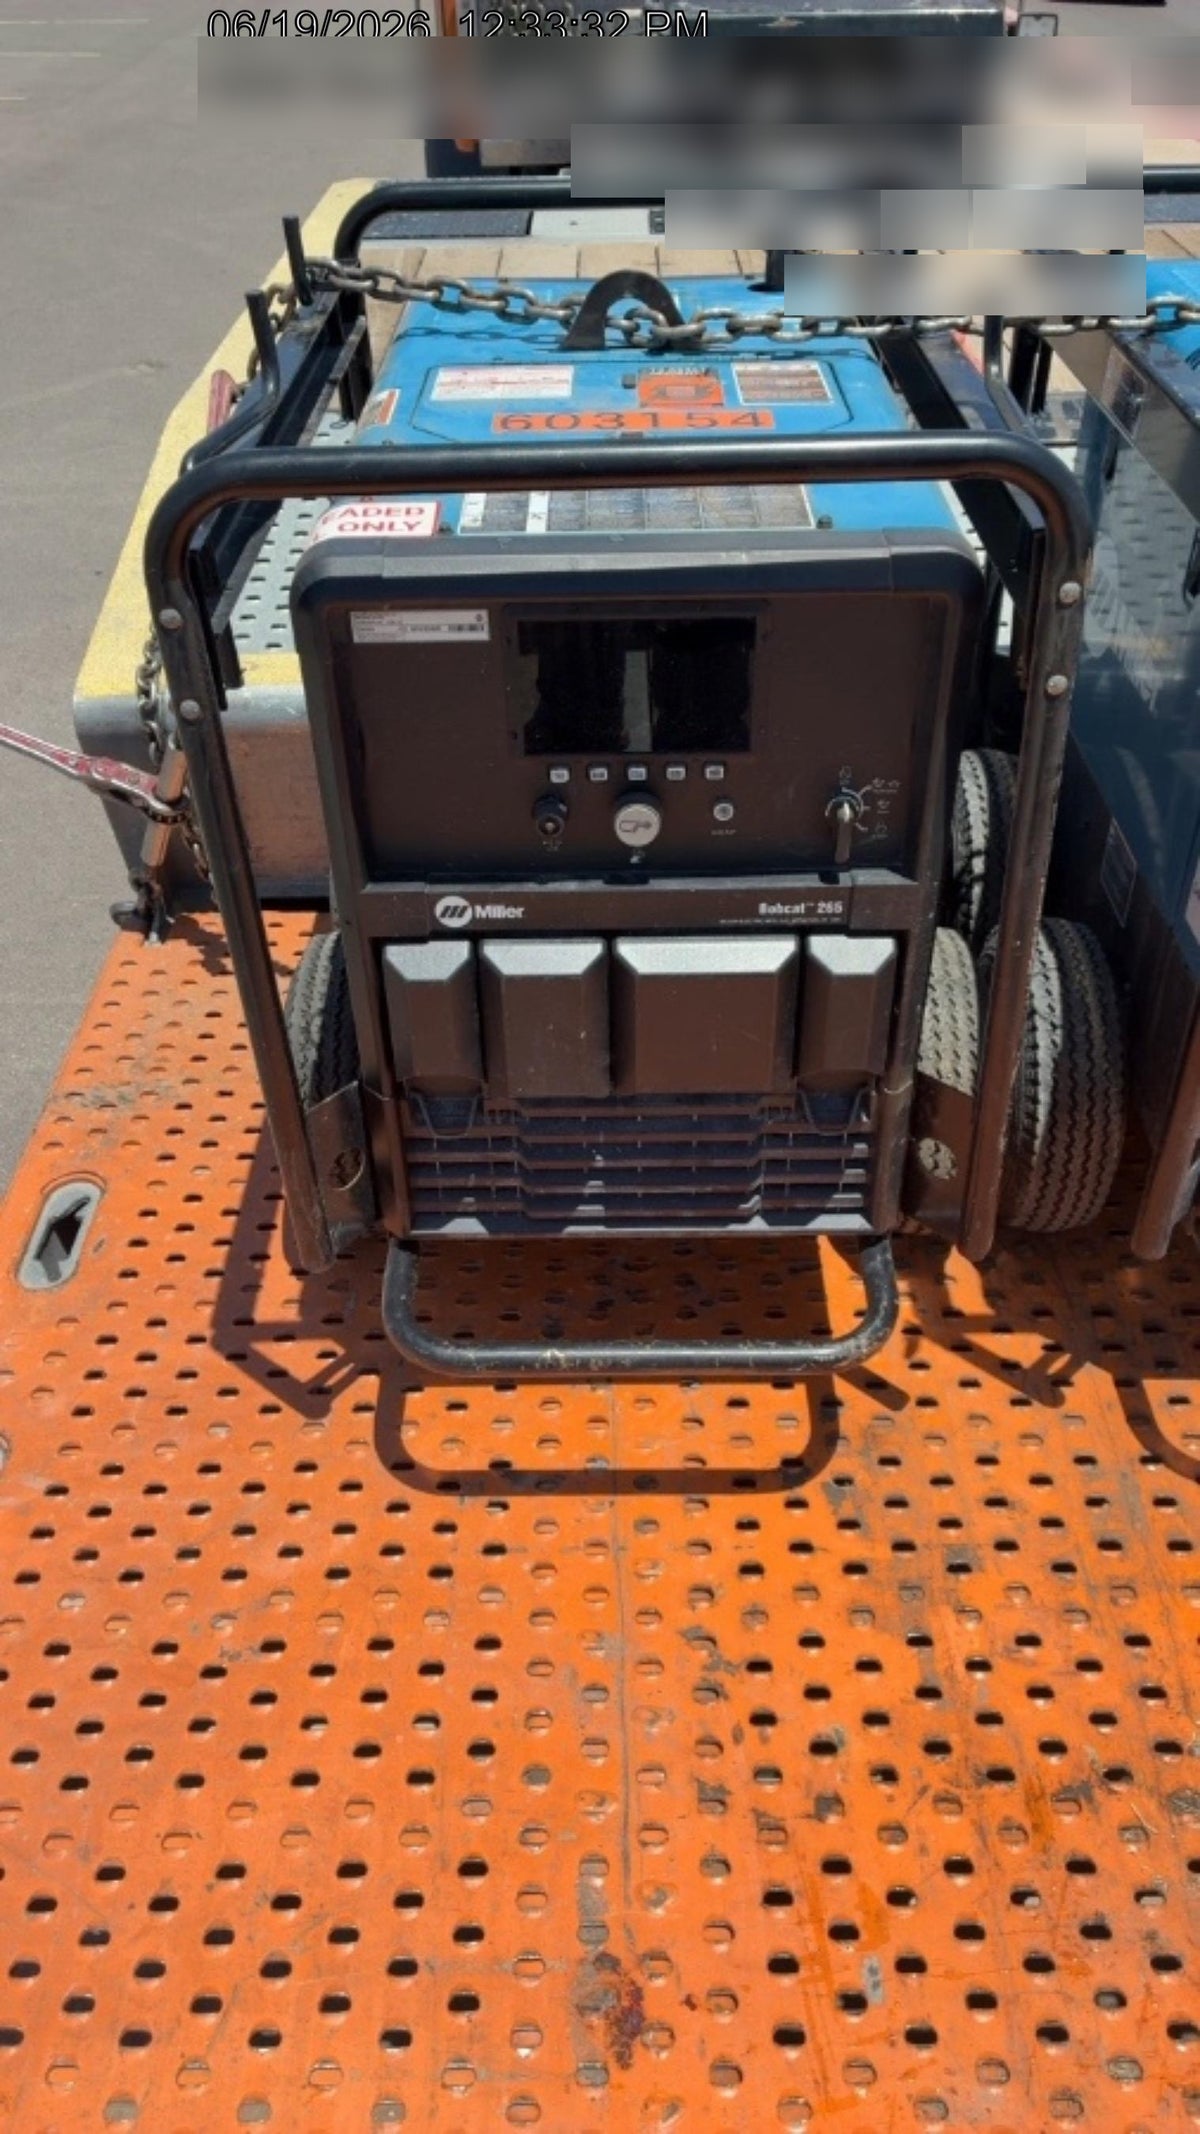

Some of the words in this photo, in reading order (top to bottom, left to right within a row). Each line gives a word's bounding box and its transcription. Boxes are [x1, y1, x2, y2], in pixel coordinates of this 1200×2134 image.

[501, 411, 762, 430] 603154
[337, 521, 421, 533] ONLY
[474, 905, 525, 918] Miller
